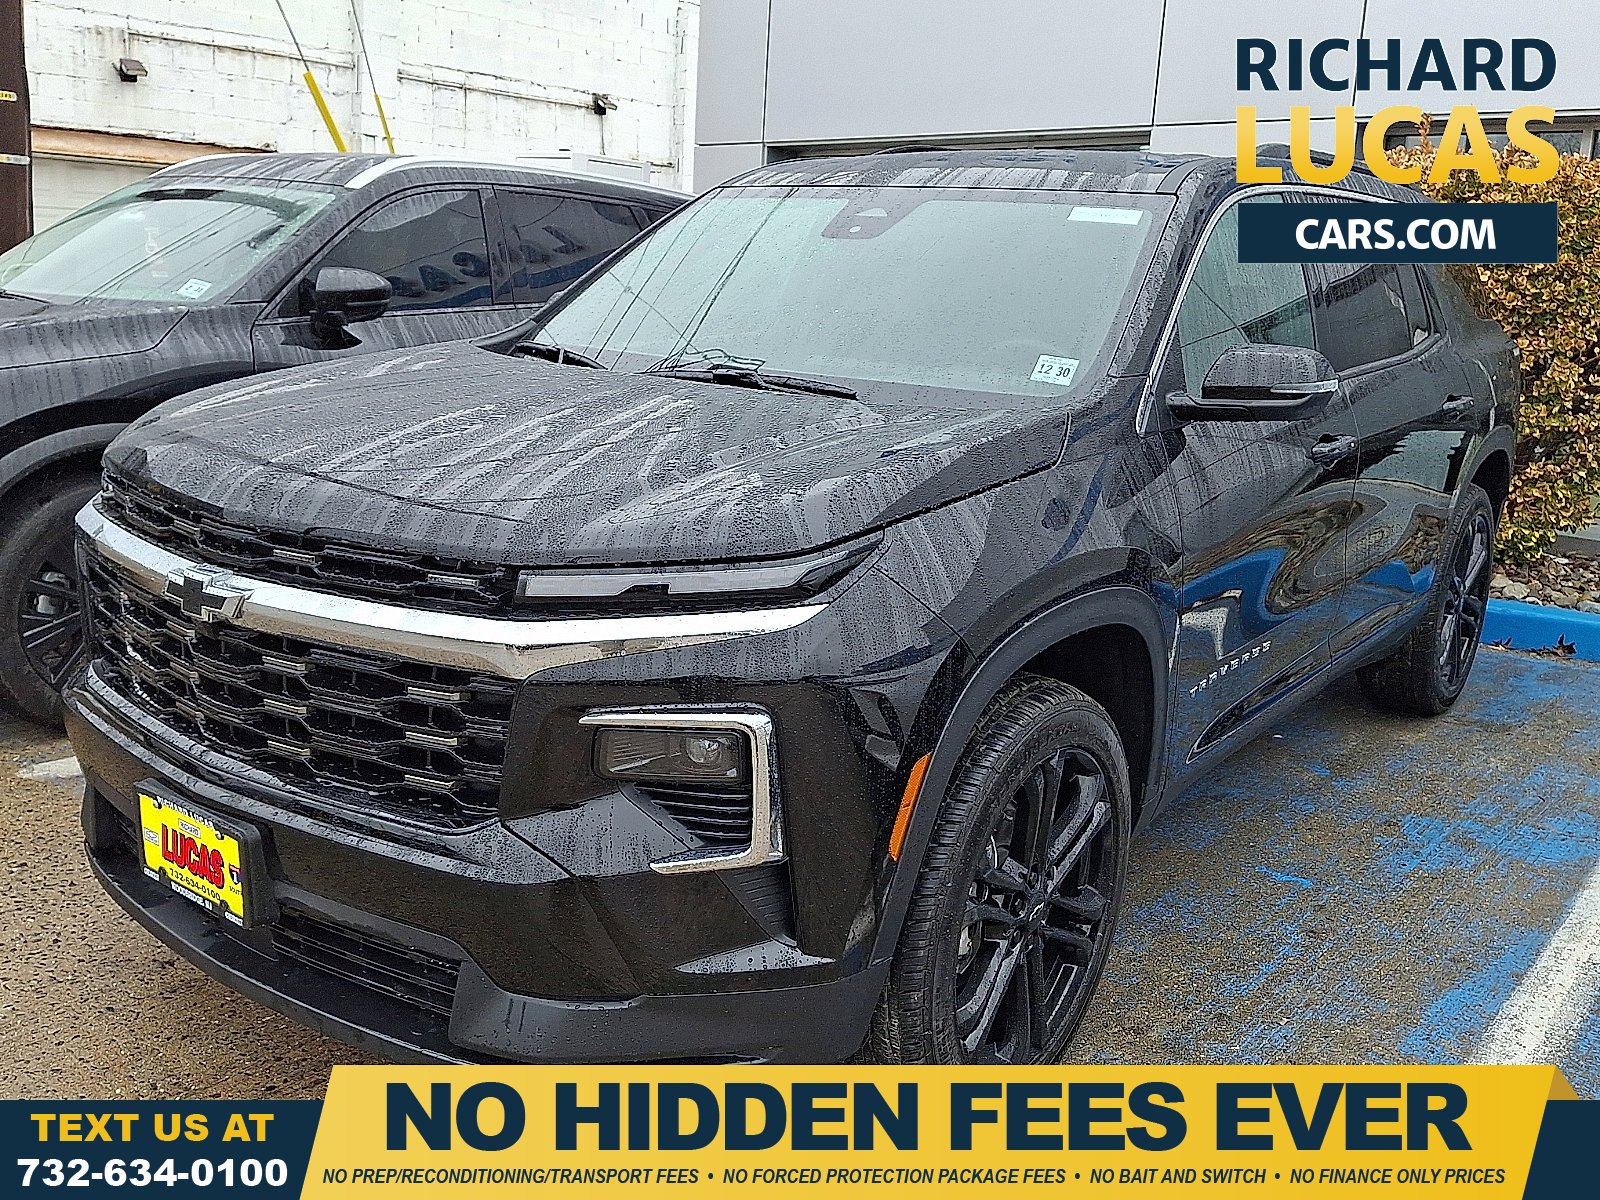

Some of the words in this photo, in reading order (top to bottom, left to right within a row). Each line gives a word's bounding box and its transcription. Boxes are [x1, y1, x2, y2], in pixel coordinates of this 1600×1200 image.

[1037, 363, 1054, 375] 12
[1055, 366, 1071, 378] 30
[1188, 640, 1272, 699] TRAVERSE
[161, 823, 225, 889] LUCAS
[169, 867, 221, 901] 732-634-0100
